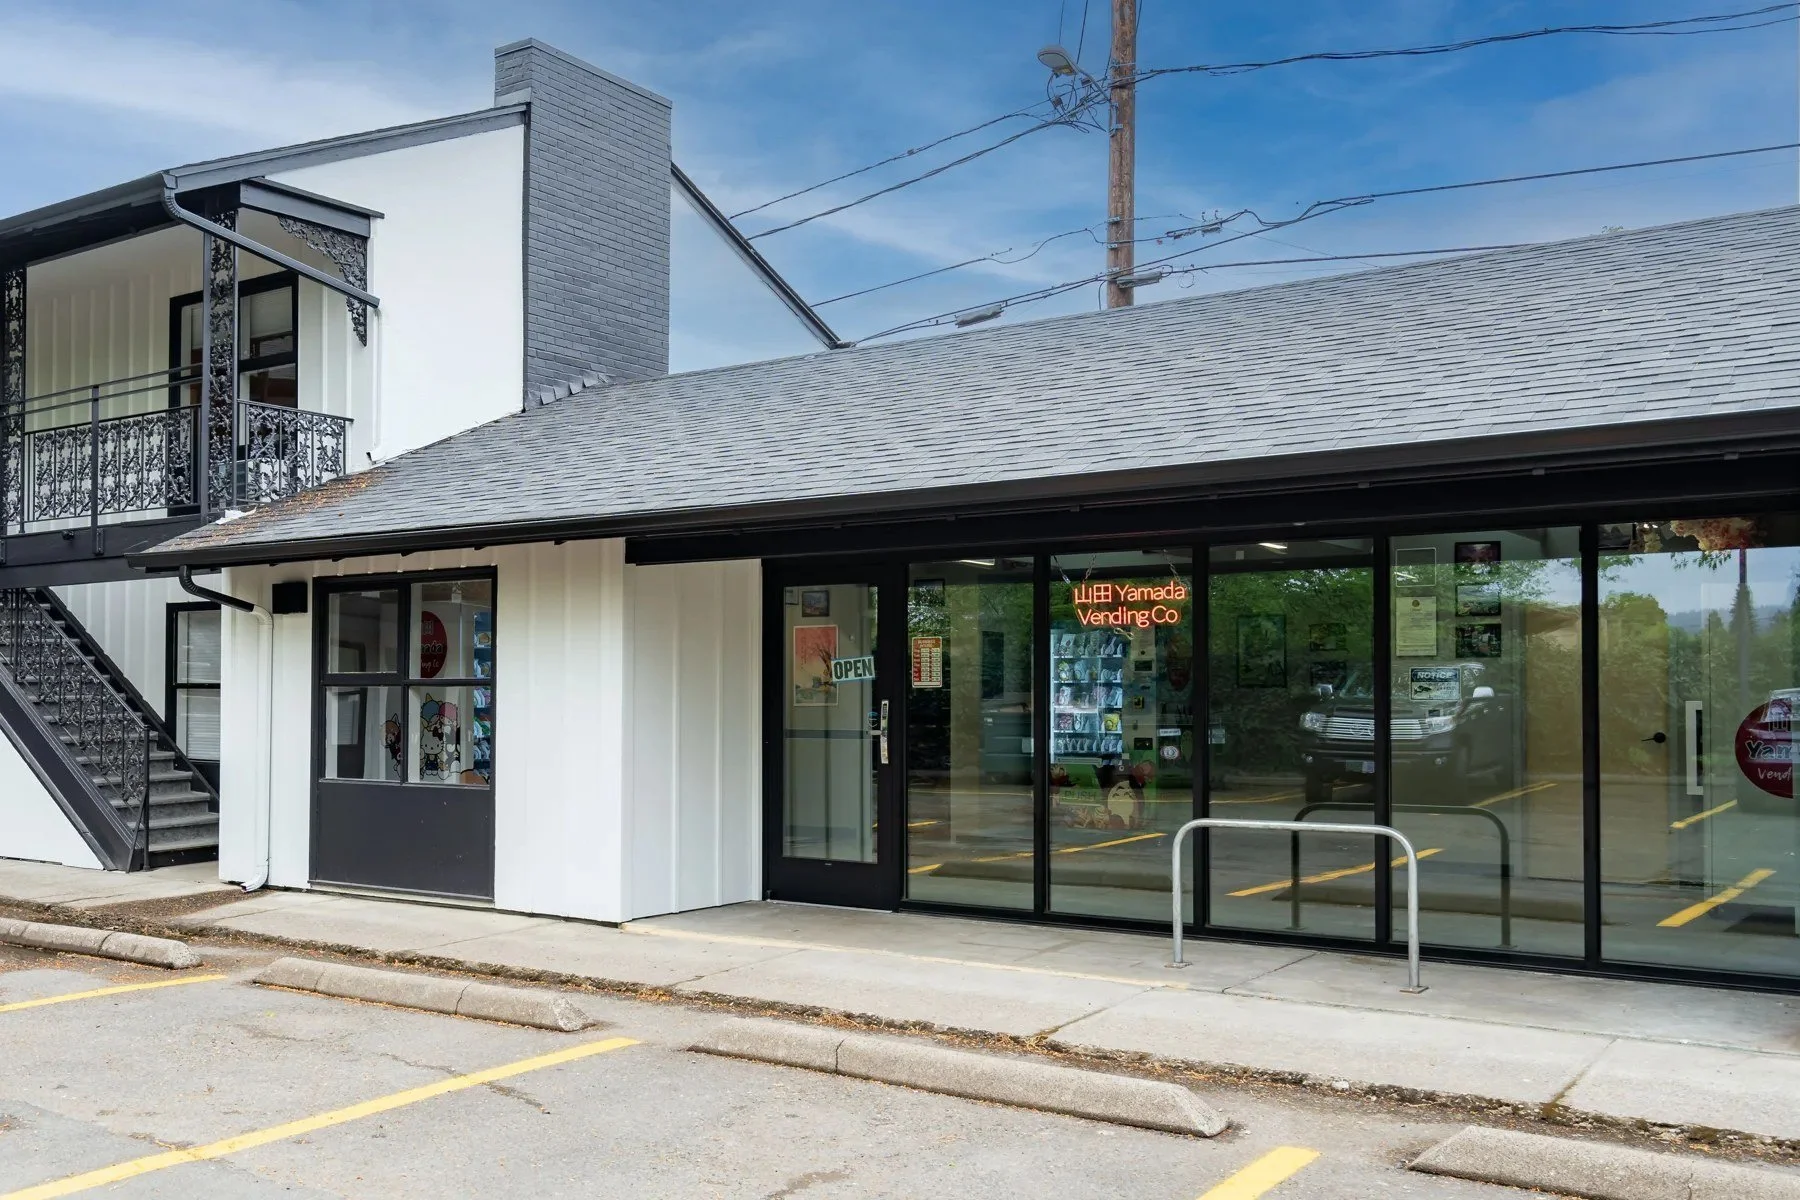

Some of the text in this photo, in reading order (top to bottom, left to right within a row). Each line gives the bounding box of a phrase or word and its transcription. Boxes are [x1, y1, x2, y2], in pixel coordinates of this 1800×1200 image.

[1074, 581, 1186, 604] 山田 Yamada
[1077, 605, 1179, 628] Vending Co
[833, 658, 874, 680] OPEN
[1416, 671, 1453, 680] NOTICE
